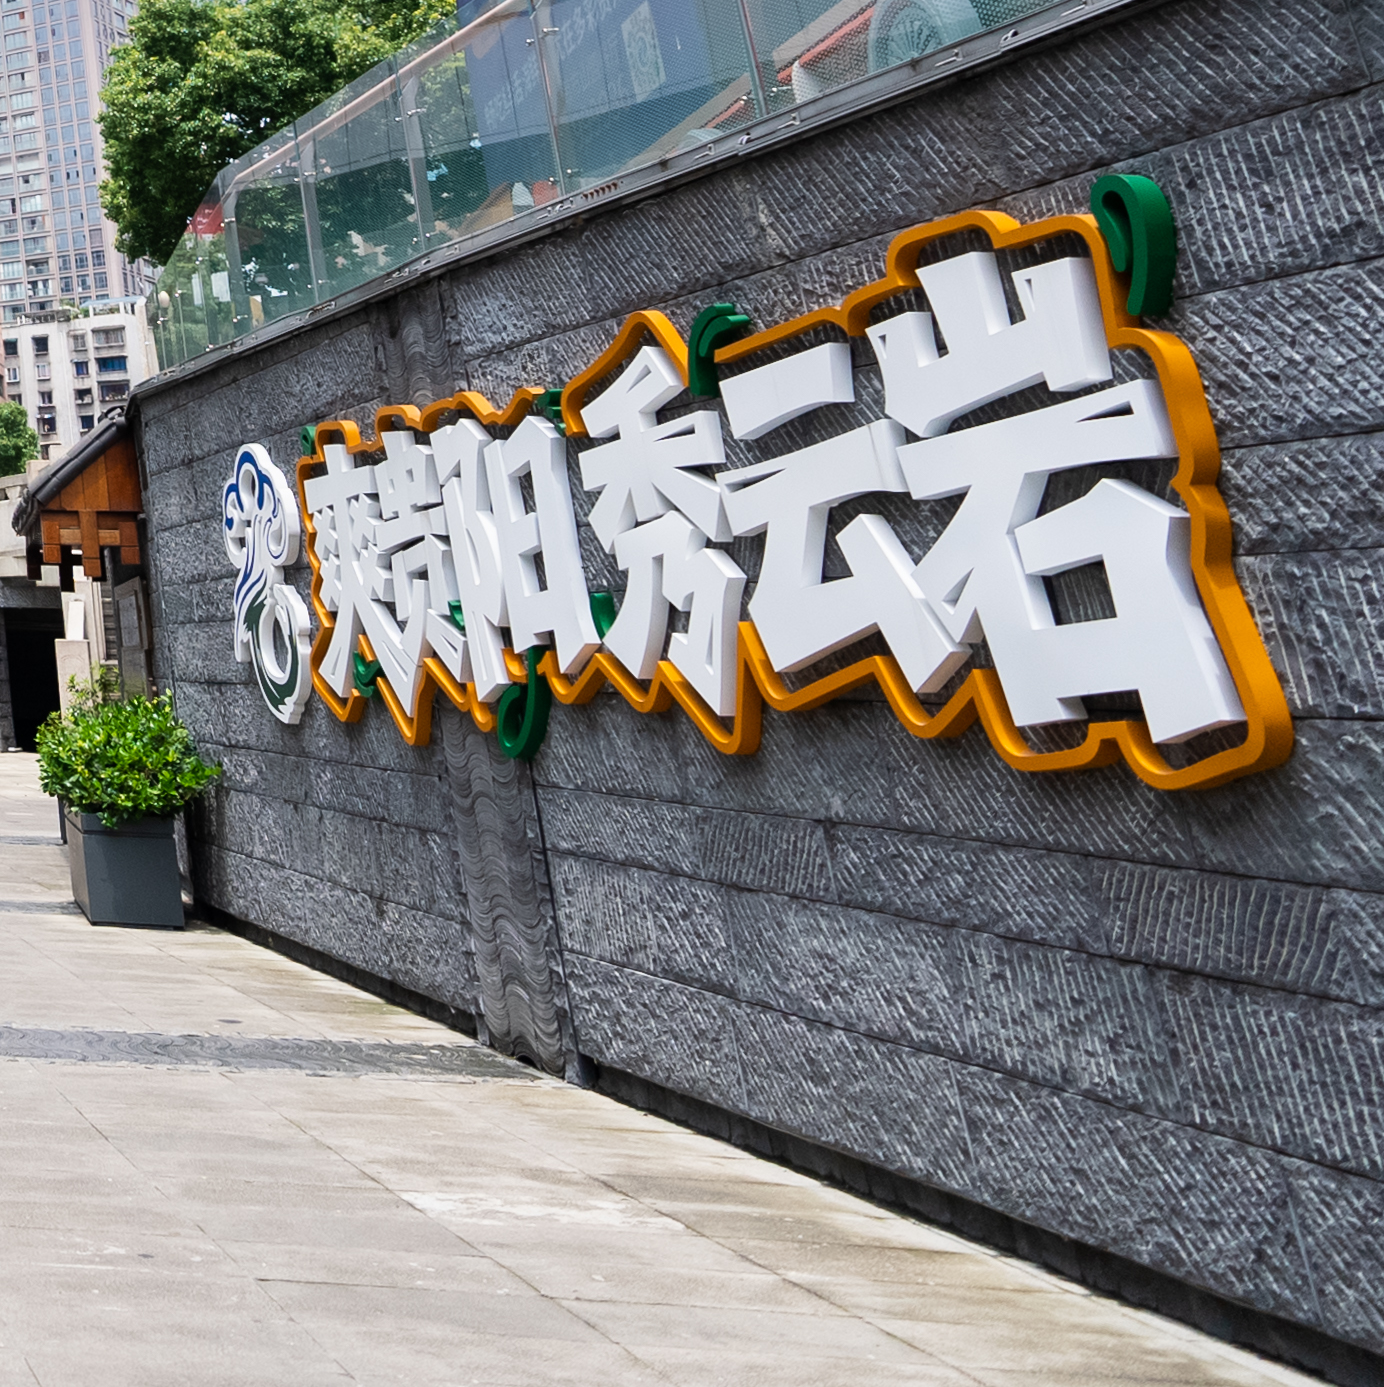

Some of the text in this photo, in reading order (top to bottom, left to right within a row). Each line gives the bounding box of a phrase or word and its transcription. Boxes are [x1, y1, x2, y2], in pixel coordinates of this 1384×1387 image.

[303, 249, 1248, 746] 爽贵阳秀云岩
